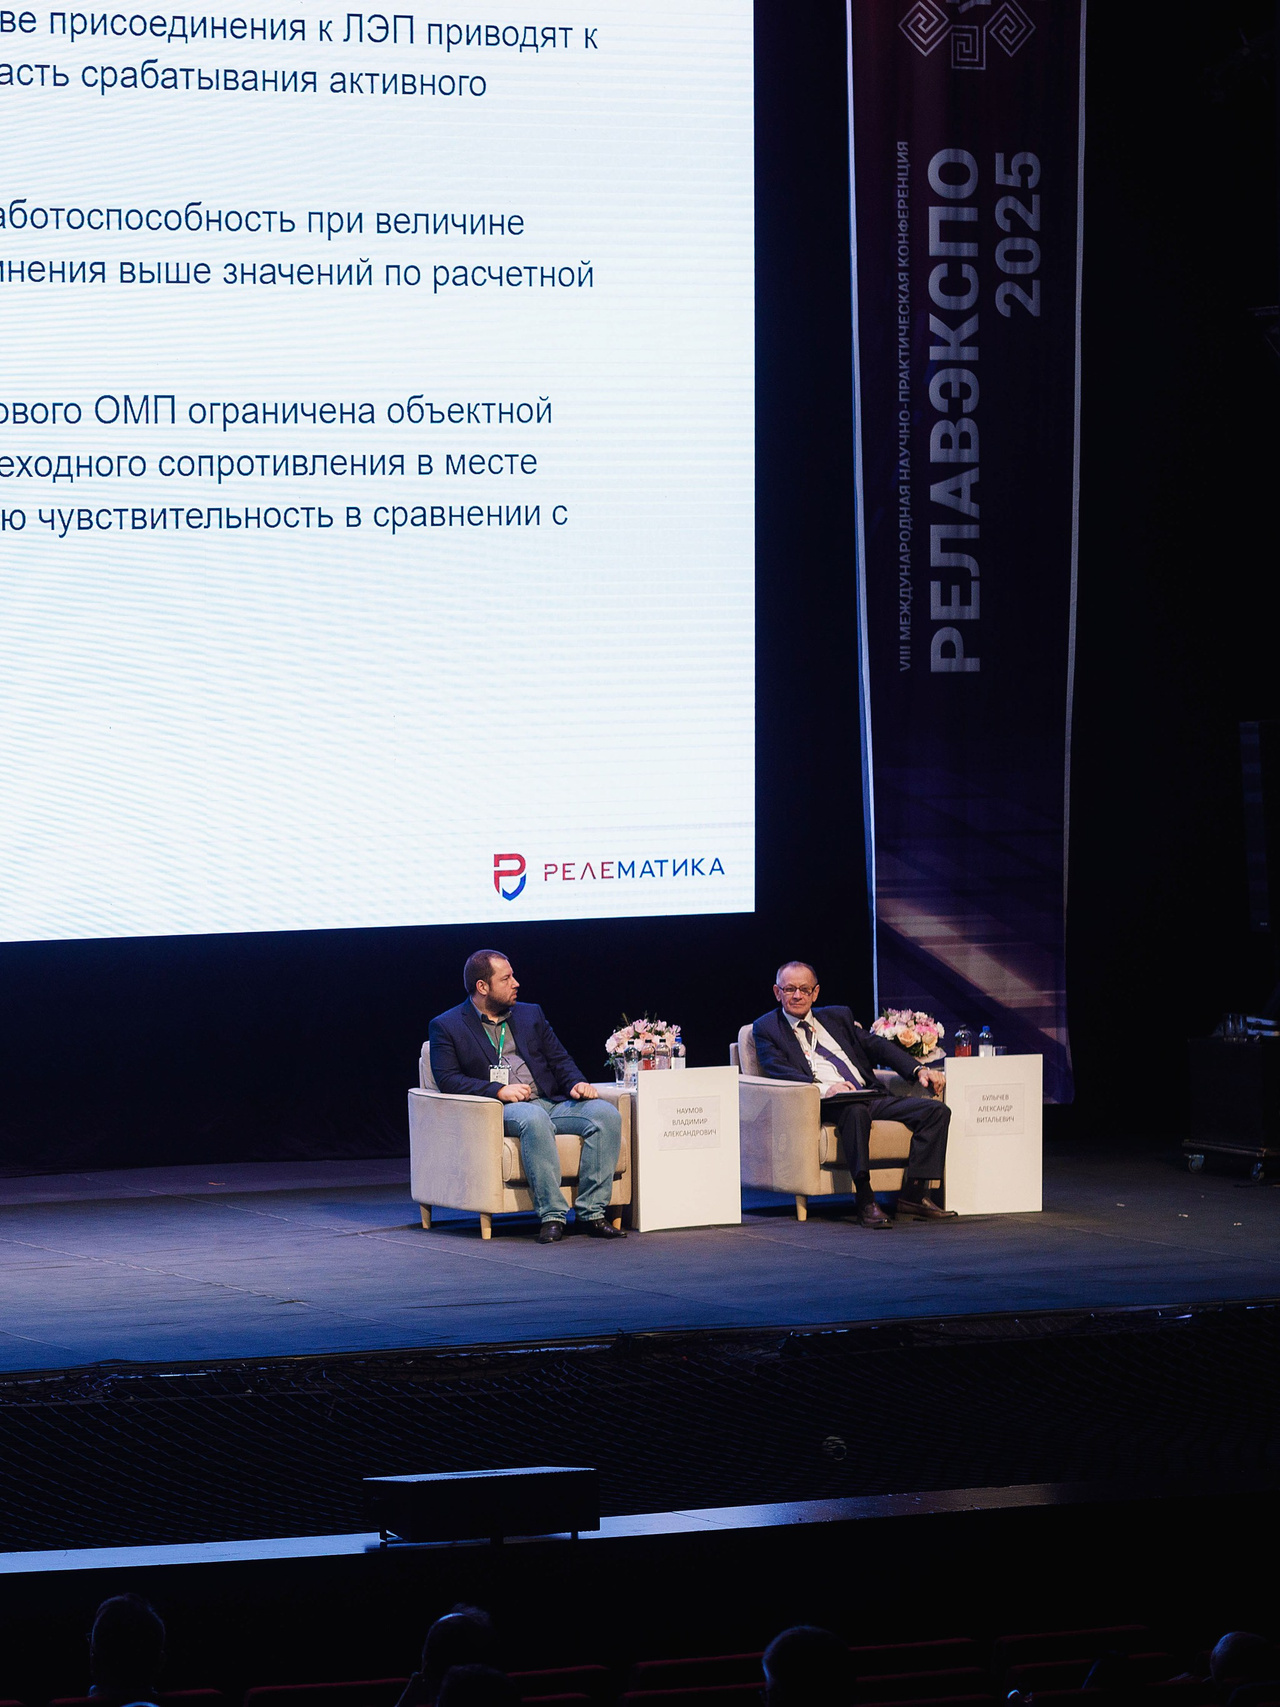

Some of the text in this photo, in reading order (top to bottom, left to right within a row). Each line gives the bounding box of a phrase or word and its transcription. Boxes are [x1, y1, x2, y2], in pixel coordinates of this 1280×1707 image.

[49, 11, 306, 45] присоединения
[319, 19, 333, 42] к
[342, 12, 414, 45] ЛЭП
[427, 23, 574, 54] приводят
[584, 27, 598, 50] к
[81, 58, 317, 97] срабатывания
[329, 71, 487, 97] активного
[308, 211, 363, 242] при
[376, 212, 525, 236] величине
[994, 151, 1041, 317] 2025
[119, 261, 211, 285] выше
[222, 257, 373, 286] значений
[385, 264, 421, 286] по
[433, 259, 594, 295] расчетной
[94, 394, 176, 425] ОМП
[188, 402, 376, 433] ограничена
[387, 393, 552, 424] объектной
[897, 141, 912, 672] VIII МЕЖДУНАРОДНАЯ НАУЧНО-ПРАКТИЧЕСКАЯ КОНФЕРЕНЦИЯ
[927, 148, 980, 672] РЕЛАВЭКСПО
[158, 454, 405, 485] сопротивления
[417, 454, 434, 476] в
[445, 453, 538, 476] месте
[38, 506, 334, 539] чувствительность
[345, 506, 362, 528] в
[373, 504, 541, 536] сравнении
[552, 504, 568, 526] с
[544, 857, 726, 882] РЕЛЕМАТИКА
[663, 1129, 717, 1138] АЛЕКСАНДРОВИЧ
[672, 1118, 708, 1126] ВЛАДИМИР
